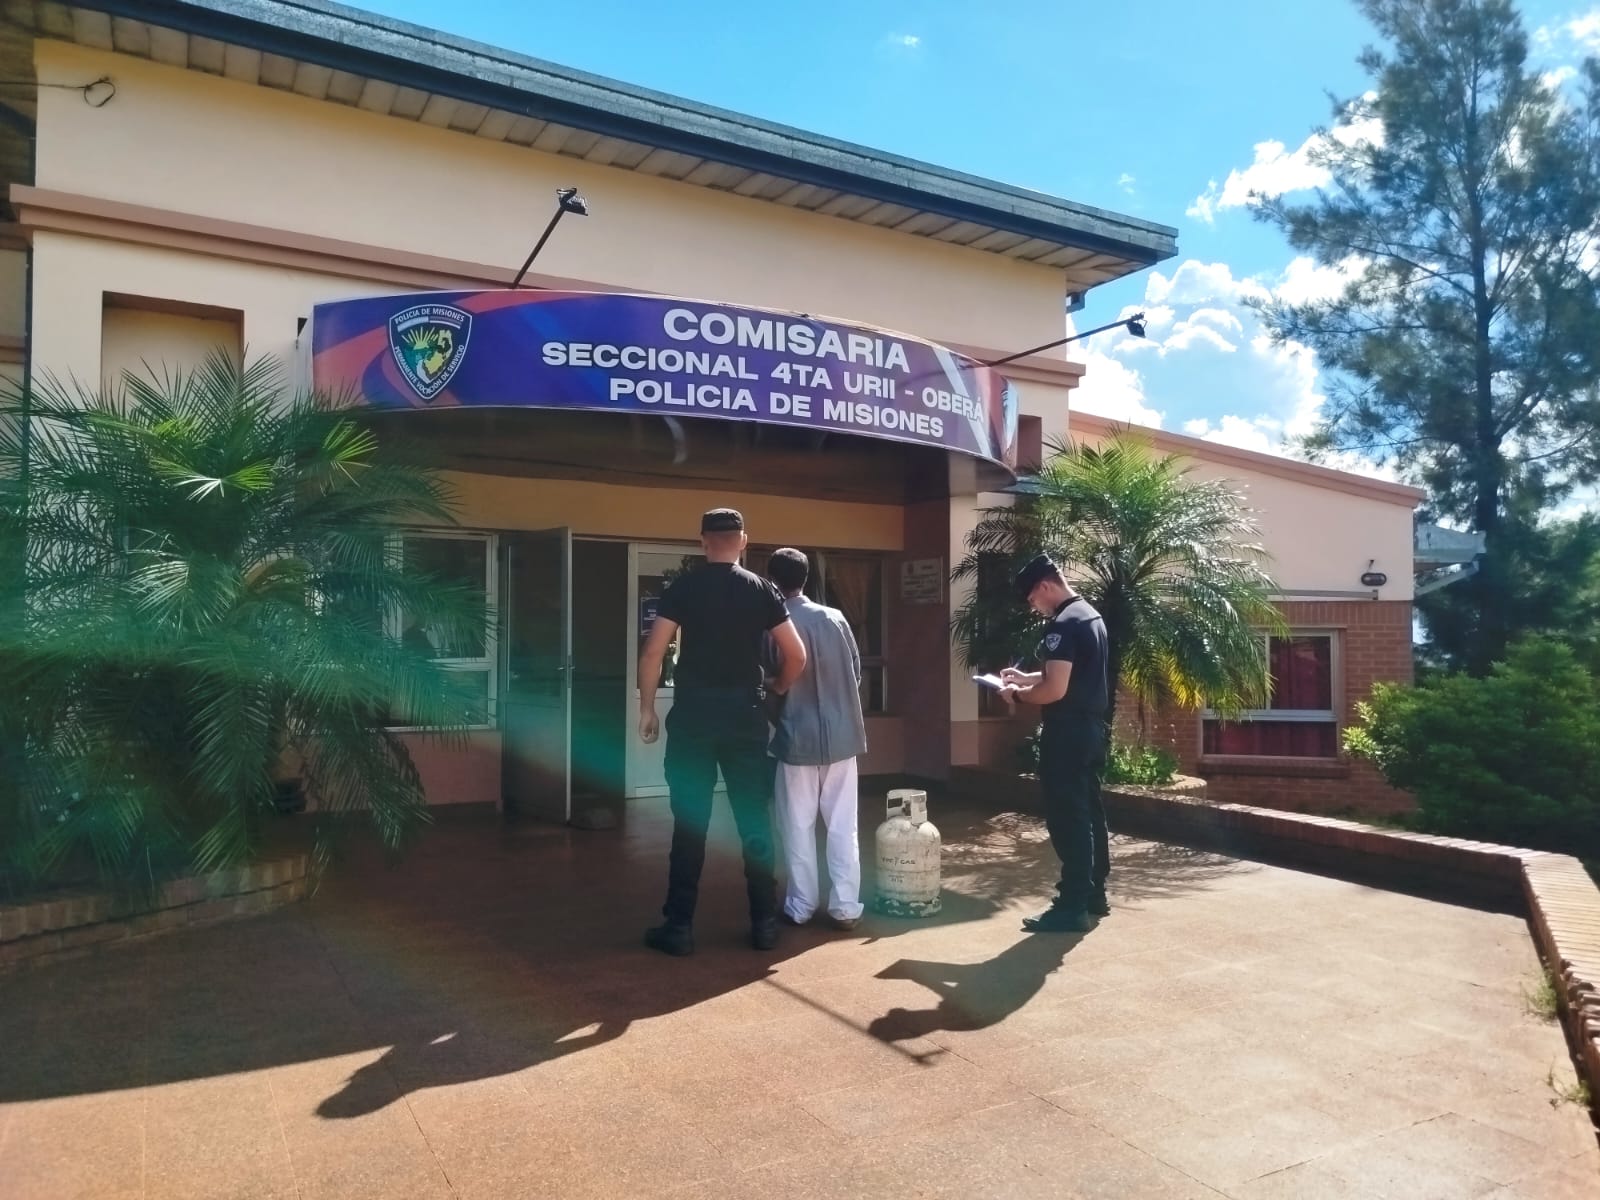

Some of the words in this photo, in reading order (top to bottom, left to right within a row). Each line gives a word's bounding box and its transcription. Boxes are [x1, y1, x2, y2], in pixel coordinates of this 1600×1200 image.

[394, 310, 420, 324] POLICIA
[432, 308, 465, 322] MISIONES
[663, 308, 911, 374] COMISARIA
[441, 371, 450, 381] DE
[447, 344, 465, 374] SERVICIO
[542, 342, 759, 381] SECCIONAL
[771, 362, 833, 390] 4TA
[843, 371, 895, 400] URII
[921, 386, 984, 423] OBERÁ
[609, 377, 758, 412] POLICIA
[770, 392, 812, 418] DE
[823, 399, 944, 438] MISIONES
